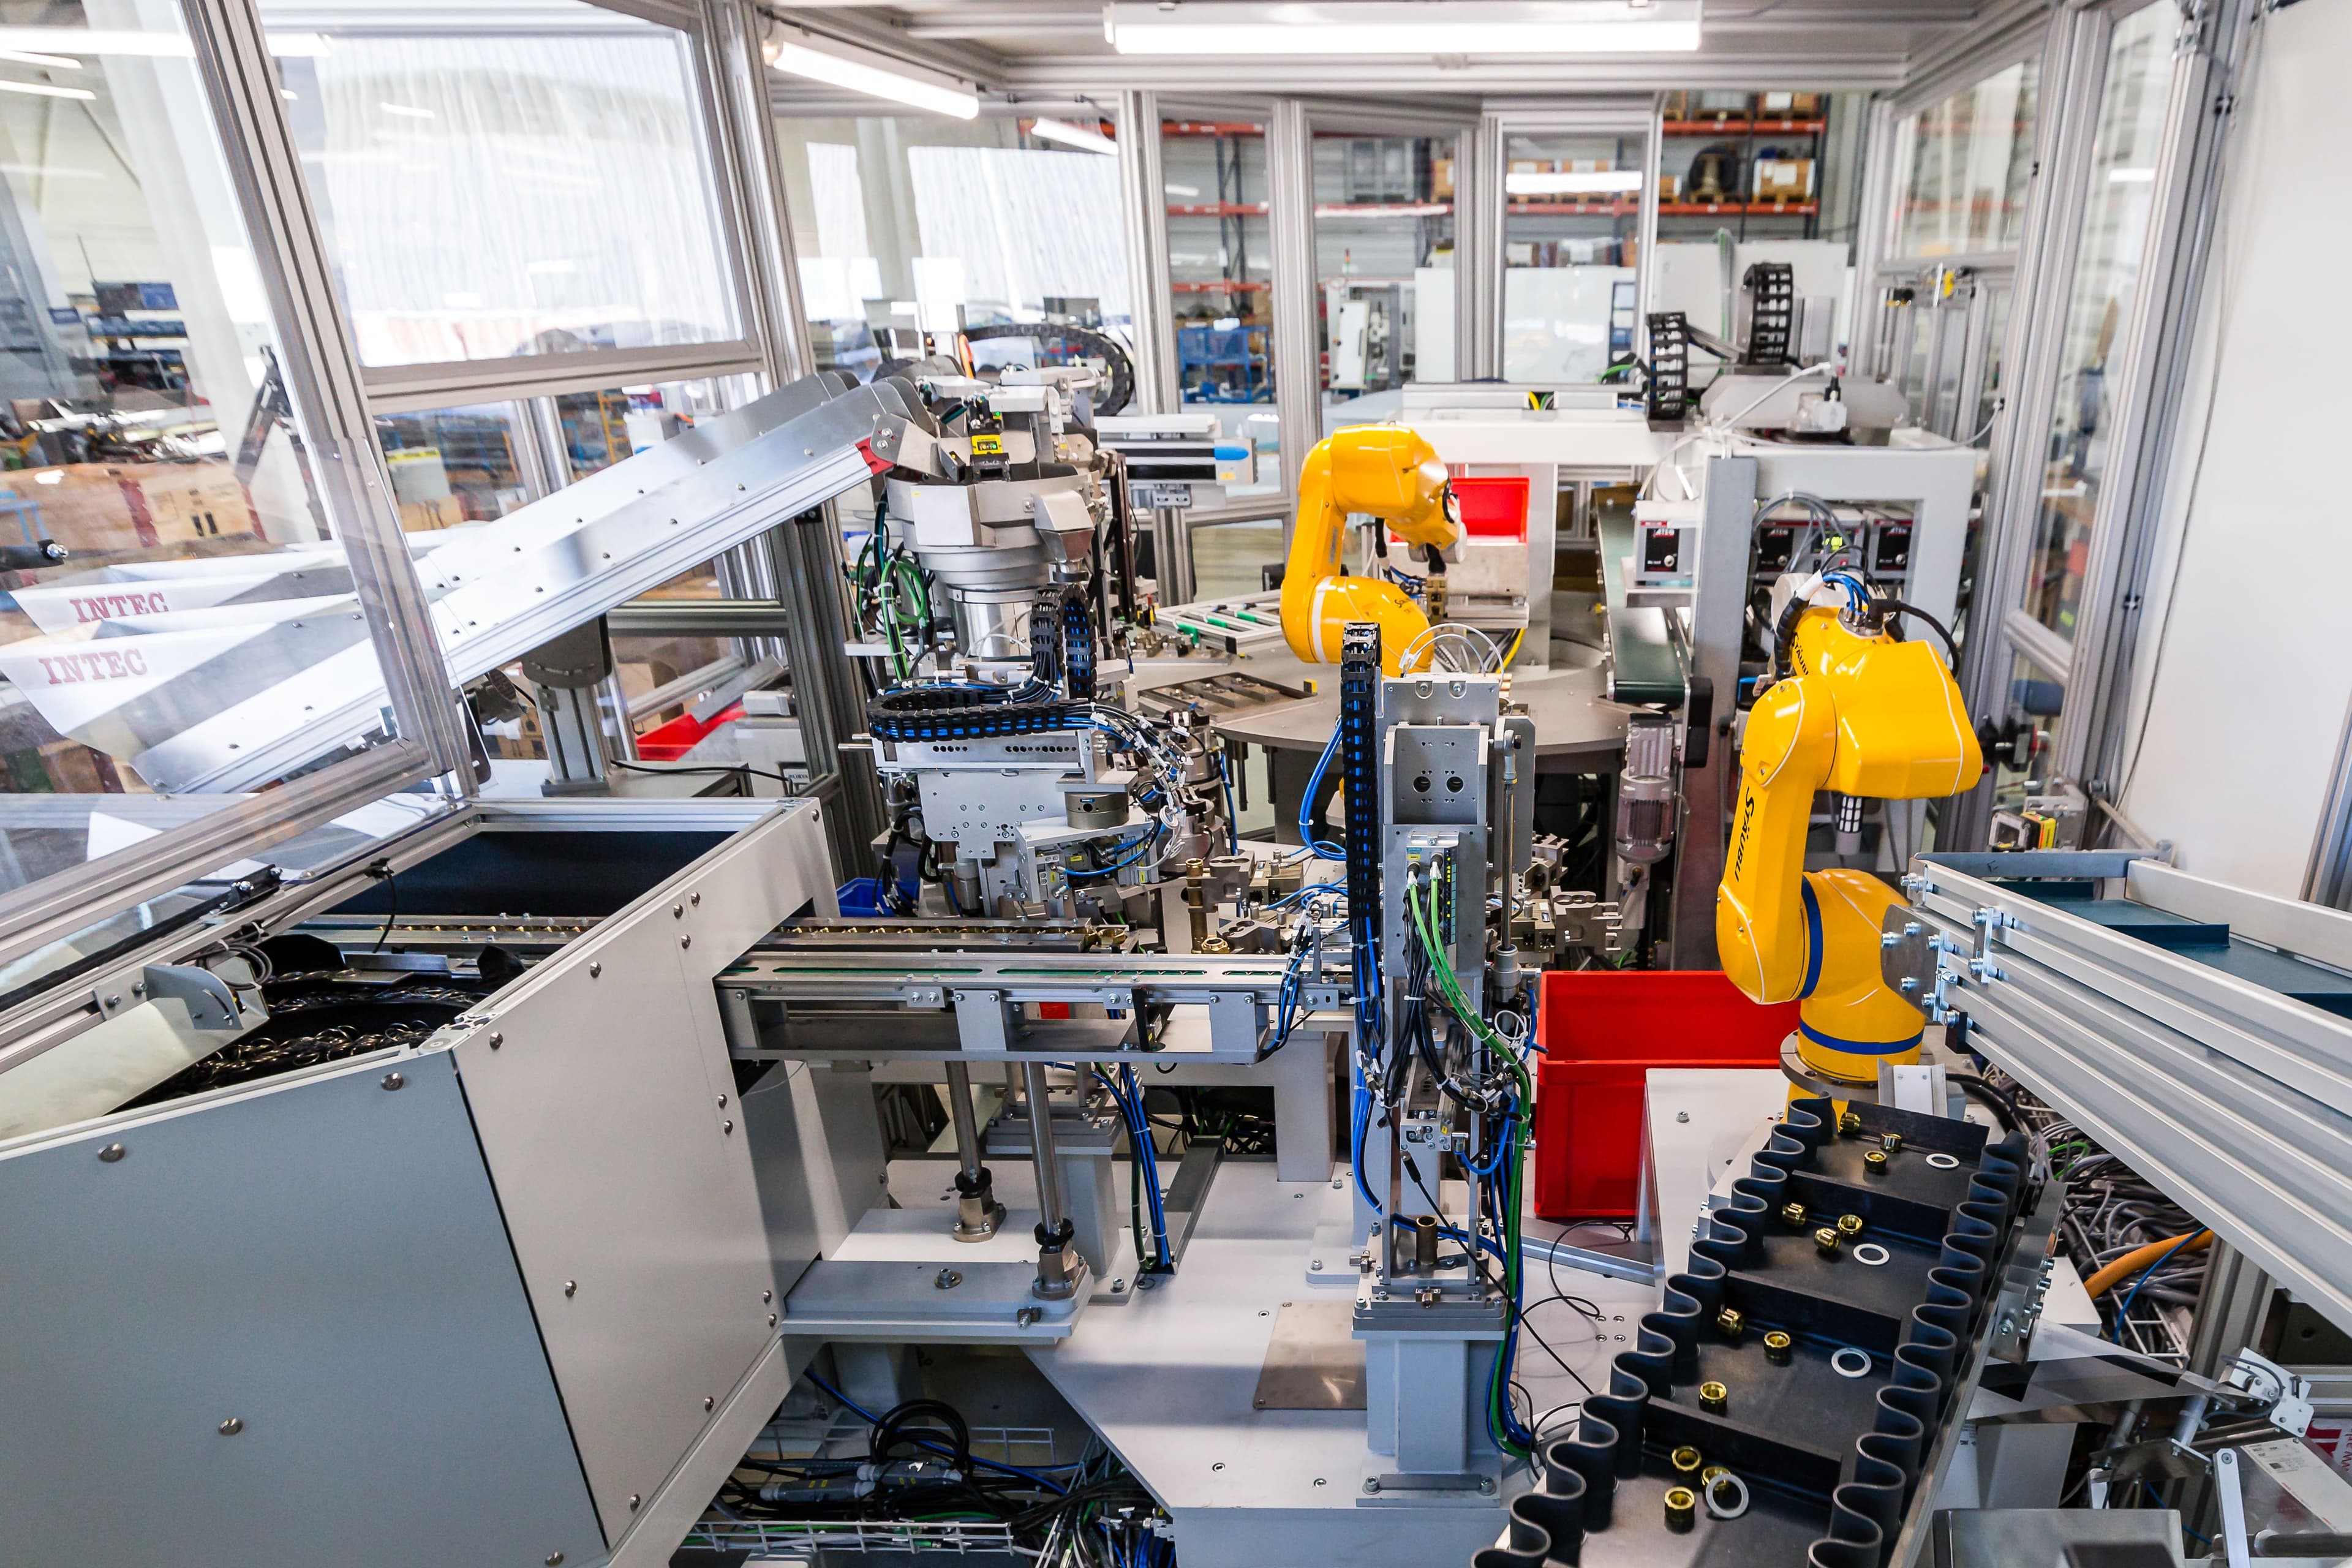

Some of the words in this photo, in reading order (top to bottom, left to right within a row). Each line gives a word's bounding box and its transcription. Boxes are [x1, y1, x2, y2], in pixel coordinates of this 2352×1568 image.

[69, 592, 169, 623] INTEC
[39, 649, 148, 685] INTEC
[1735, 786, 1755, 883] STÄUBLI
